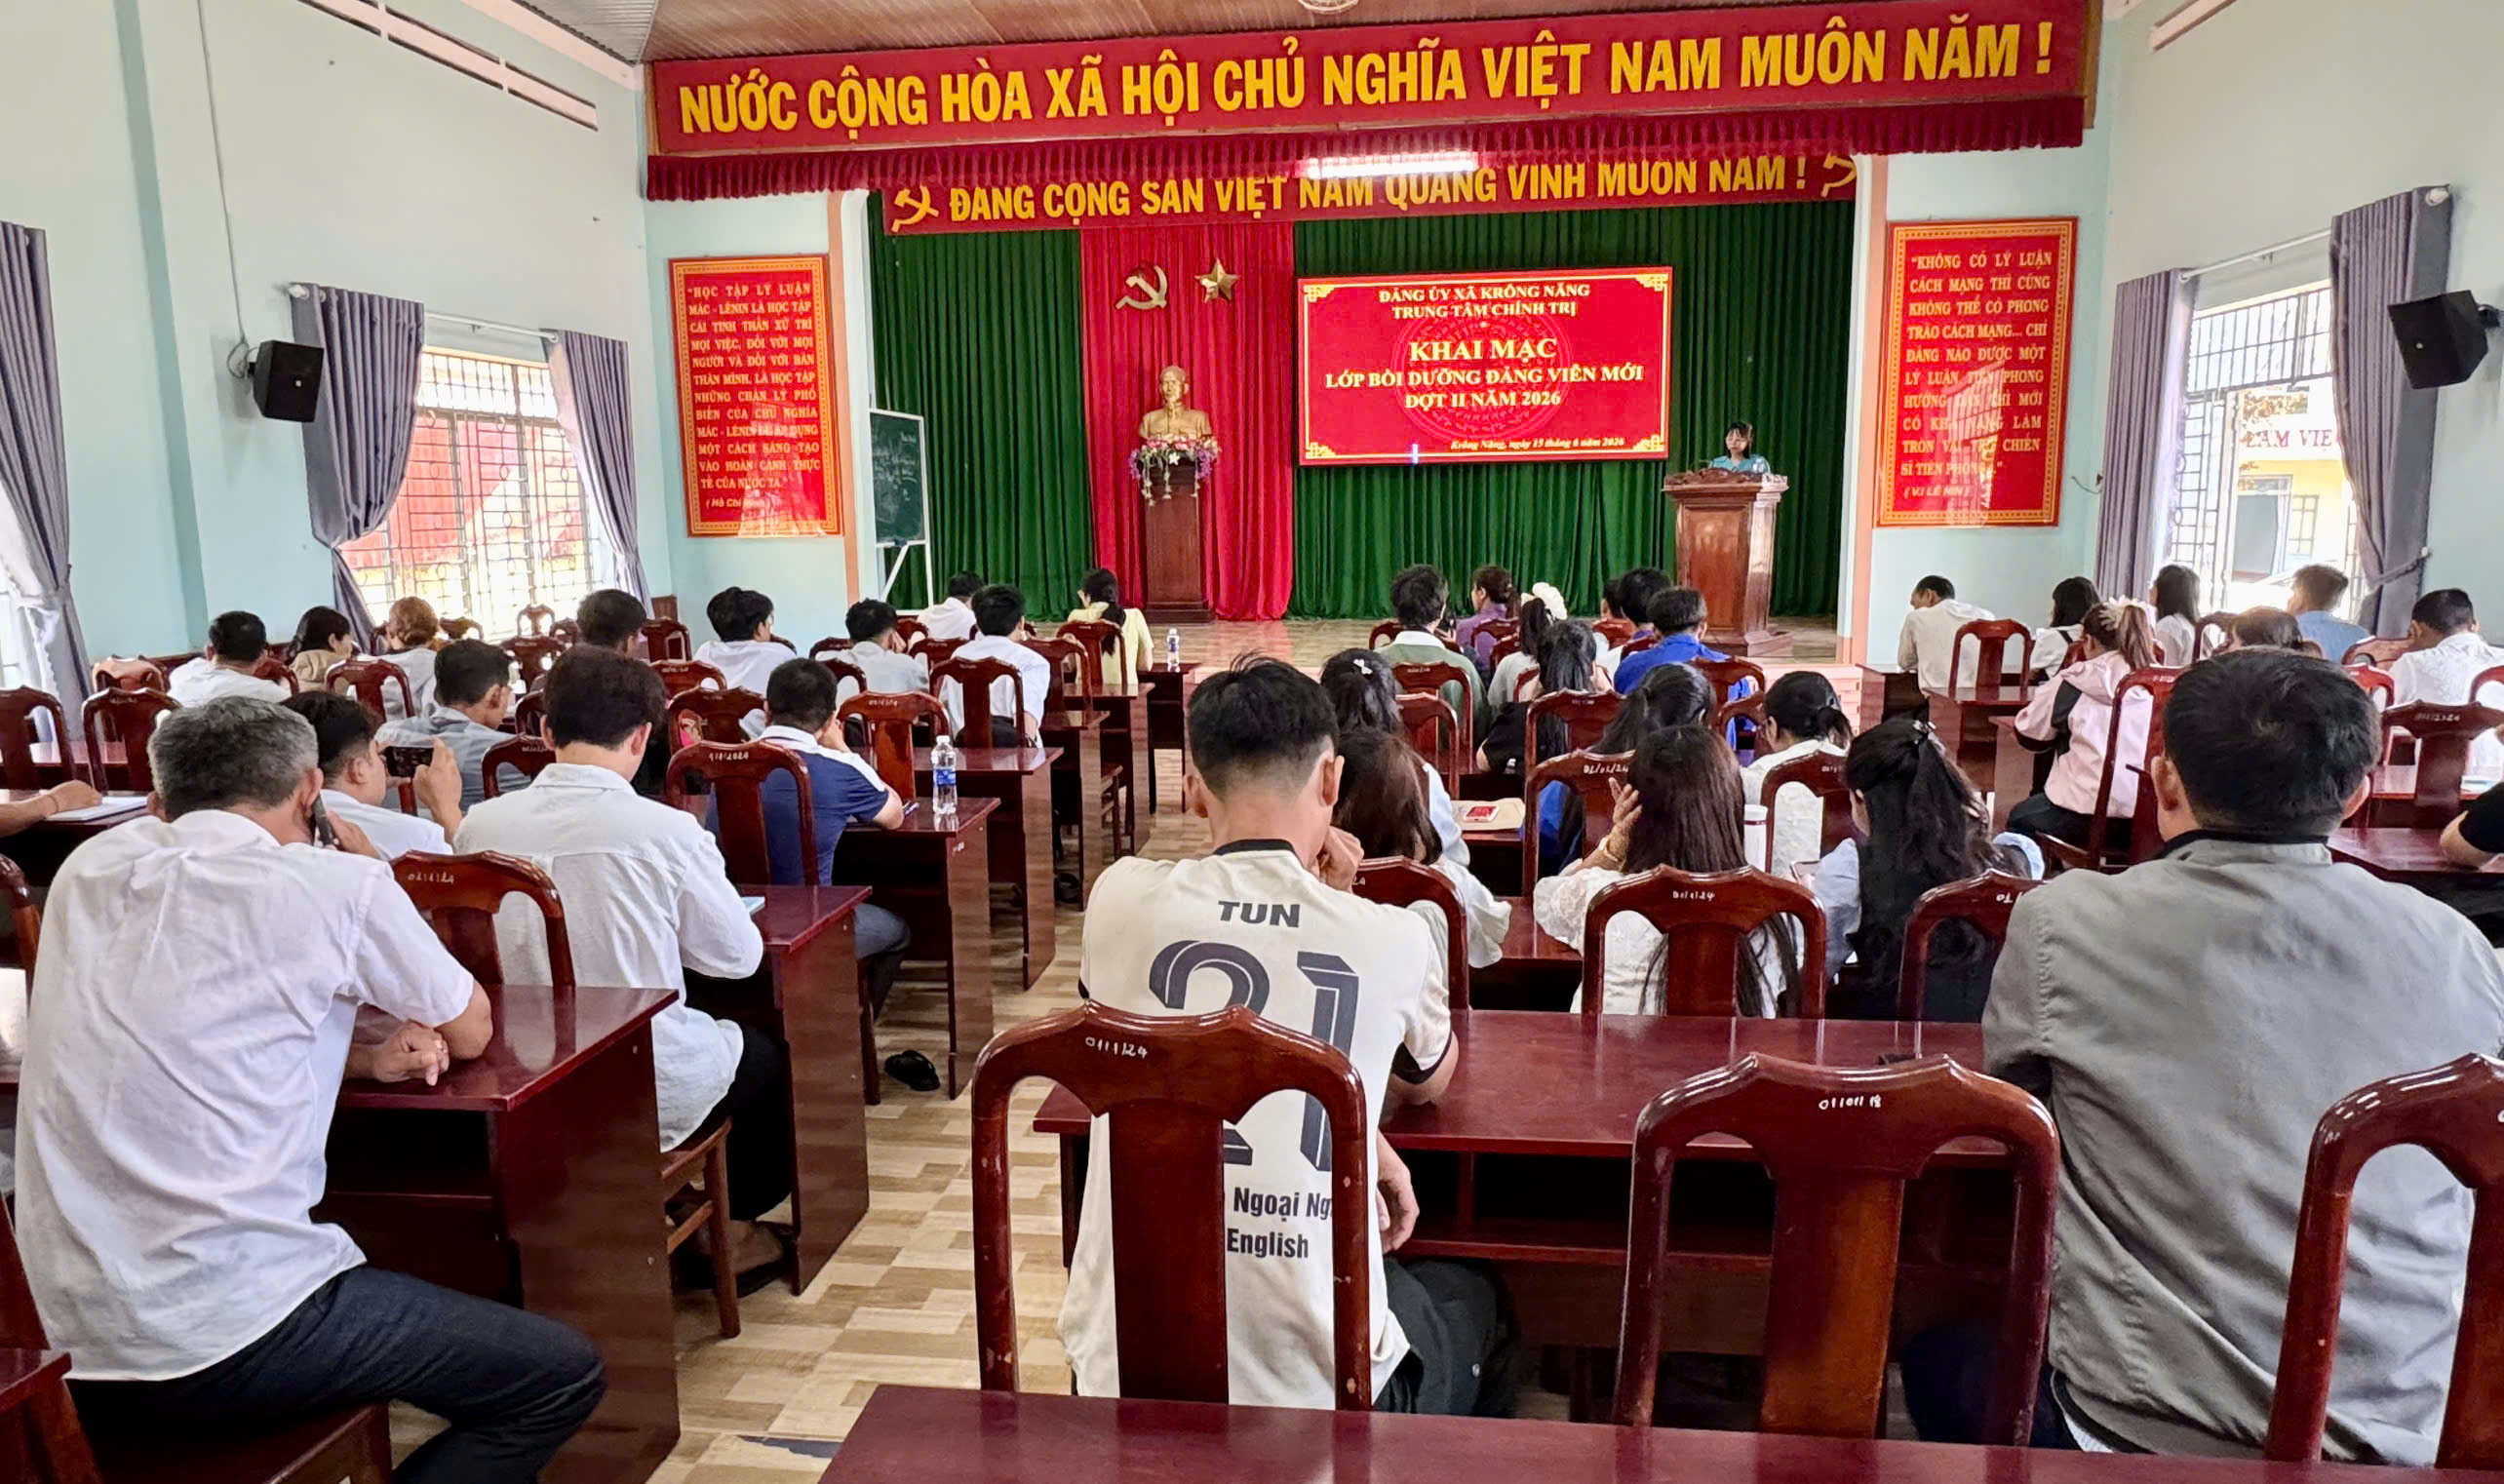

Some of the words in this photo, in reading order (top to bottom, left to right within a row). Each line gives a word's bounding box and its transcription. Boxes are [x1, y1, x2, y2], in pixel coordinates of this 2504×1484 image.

[680, 67, 798, 134] NƯỚC
[808, 64, 928, 140] CỘNG
[940, 57, 1033, 122] HÒA
[1045, 54, 1108, 119] XÃ
[1121, 48, 1200, 127] HỘI
[1213, 36, 1305, 112] CHỦ
[1323, 36, 1467, 105] NGHĨA
[1481, 29, 1591, 109] VIỆT
[1610, 37, 1722, 94] NAM
[1740, 16, 1886, 88] MUÔN
[1902, 13, 2020, 82] NĂM
[2036, 21, 2053, 75] !
[1299, 176, 1373, 210] NAM
[1385, 168, 1497, 211] QUANG
[1507, 163, 1585, 200] VINH
[1379, 288, 1425, 303] ĐẢNG
[1454, 285, 1477, 300] XÃ
[1481, 284, 1539, 299] KRÔNG
[1543, 282, 1590, 297] NĂNG
[1391, 305, 1448, 319] TRUNG
[1451, 303, 1488, 317] TÂM
[1491, 301, 1545, 315] CHÍNH
[1547, 301, 1576, 317] TRỊ
[2007, 298, 2049, 313] PHONG
[1410, 340, 1483, 361] KHAI
[1491, 338, 1557, 363] MẠC
[1325, 369, 1365, 388] LỚP
[1408, 368, 1481, 385] DƯỠNG
[1485, 366, 1544, 384] ĐẢNG
[1547, 363, 1596, 382] VIÊN
[1601, 362, 1645, 381] MỚI
[2003, 370, 2044, 383] PHONG
[1451, 393, 1466, 408] II
[1471, 390, 1516, 407] NĂM
[1521, 391, 1561, 407] 2026
[1218, 900, 1301, 928] TUN
[1233, 1187, 1300, 1223] Ngoại
[1306, 1192, 1333, 1221] Ng
[1227, 1228, 1309, 1259] English
